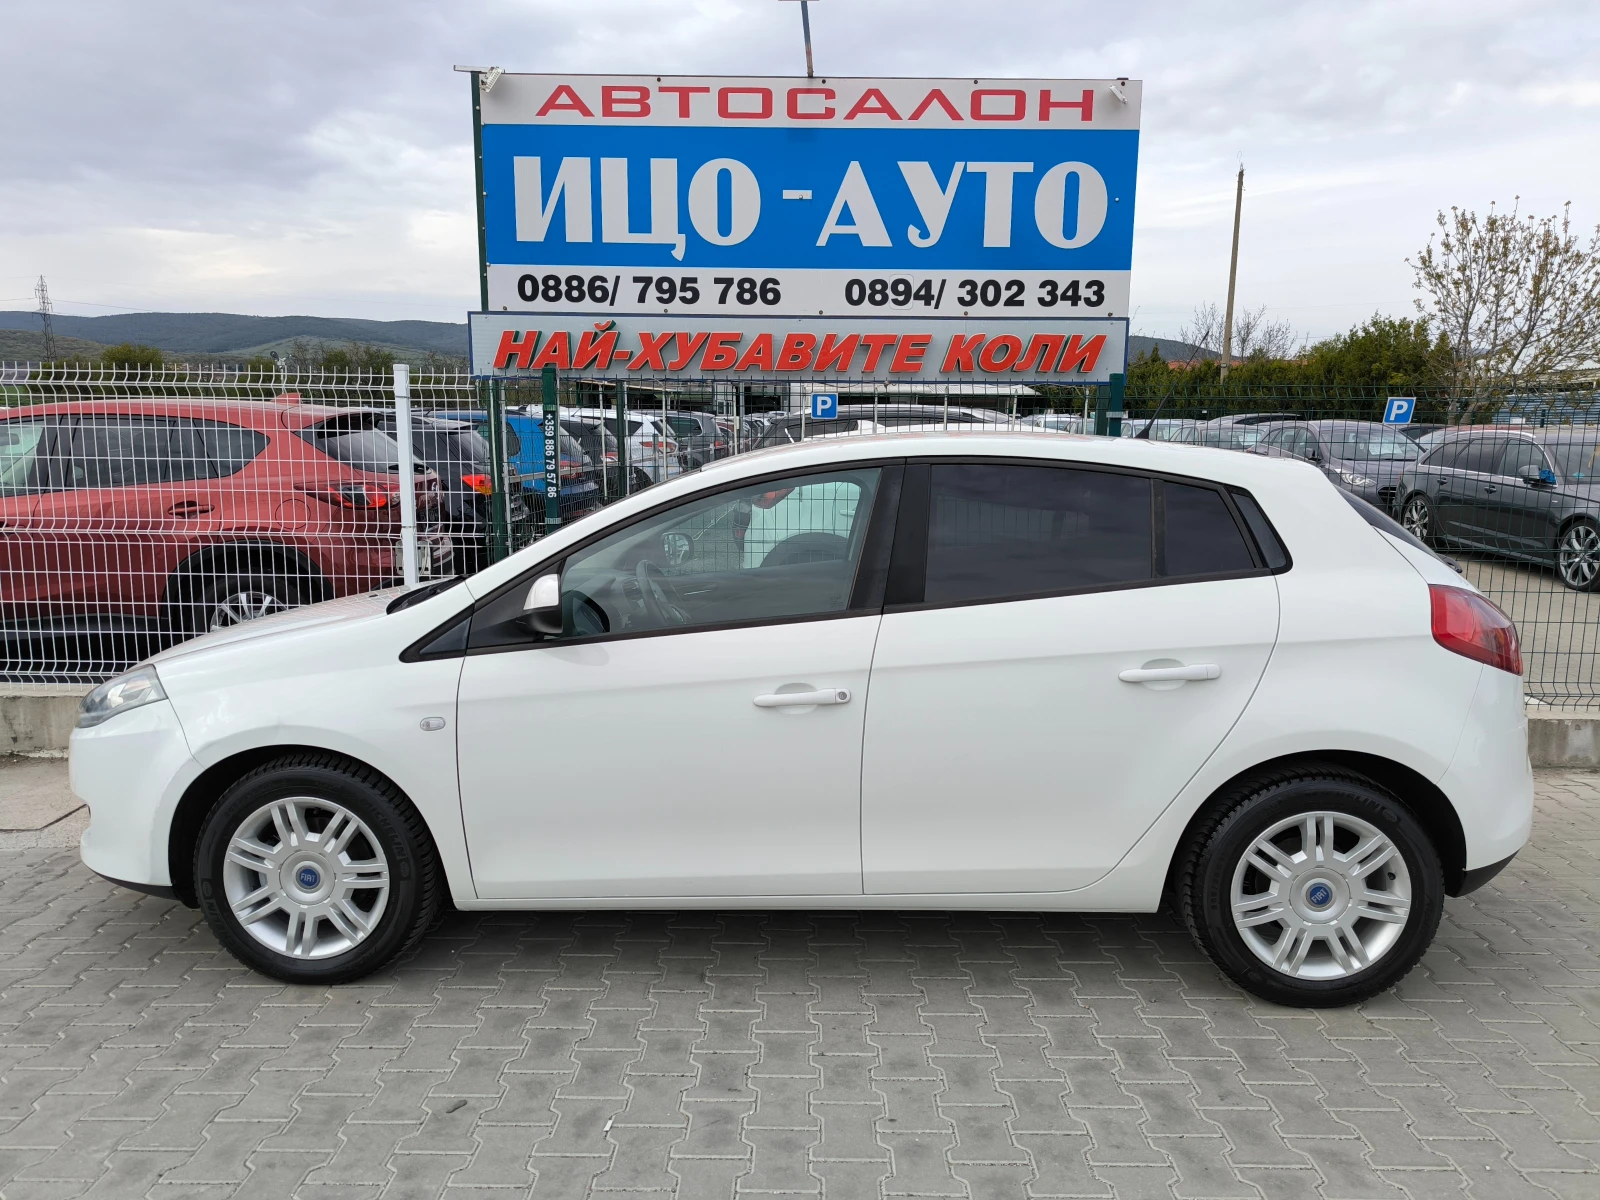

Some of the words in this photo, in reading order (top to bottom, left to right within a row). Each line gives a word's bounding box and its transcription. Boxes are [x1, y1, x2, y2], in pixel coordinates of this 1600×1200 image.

[535, 84, 1094, 122] АВТОСАЛОН
[517, 273, 621, 306] 0886/
[632, 276, 700, 304] 795
[713, 277, 782, 305] 786
[845, 278, 947, 309] 0894/
[957, 279, 1026, 307] 302
[1037, 279, 1105, 308] 343
[492, 319, 933, 373] НАЙ-ХУБАВИТЕ
[939, 332, 1108, 374] КОЛИ
[816, 395, 832, 417] P
[1389, 400, 1408, 421] P
[545, 413, 554, 437] +359
[545, 439, 555, 456] 886
[546, 459, 556, 470] 79
[546, 472, 557, 484] 57
[547, 486, 557, 498] 86
[300, 872, 316, 883] FIAT
[1310, 888, 1327, 904] FIAT
